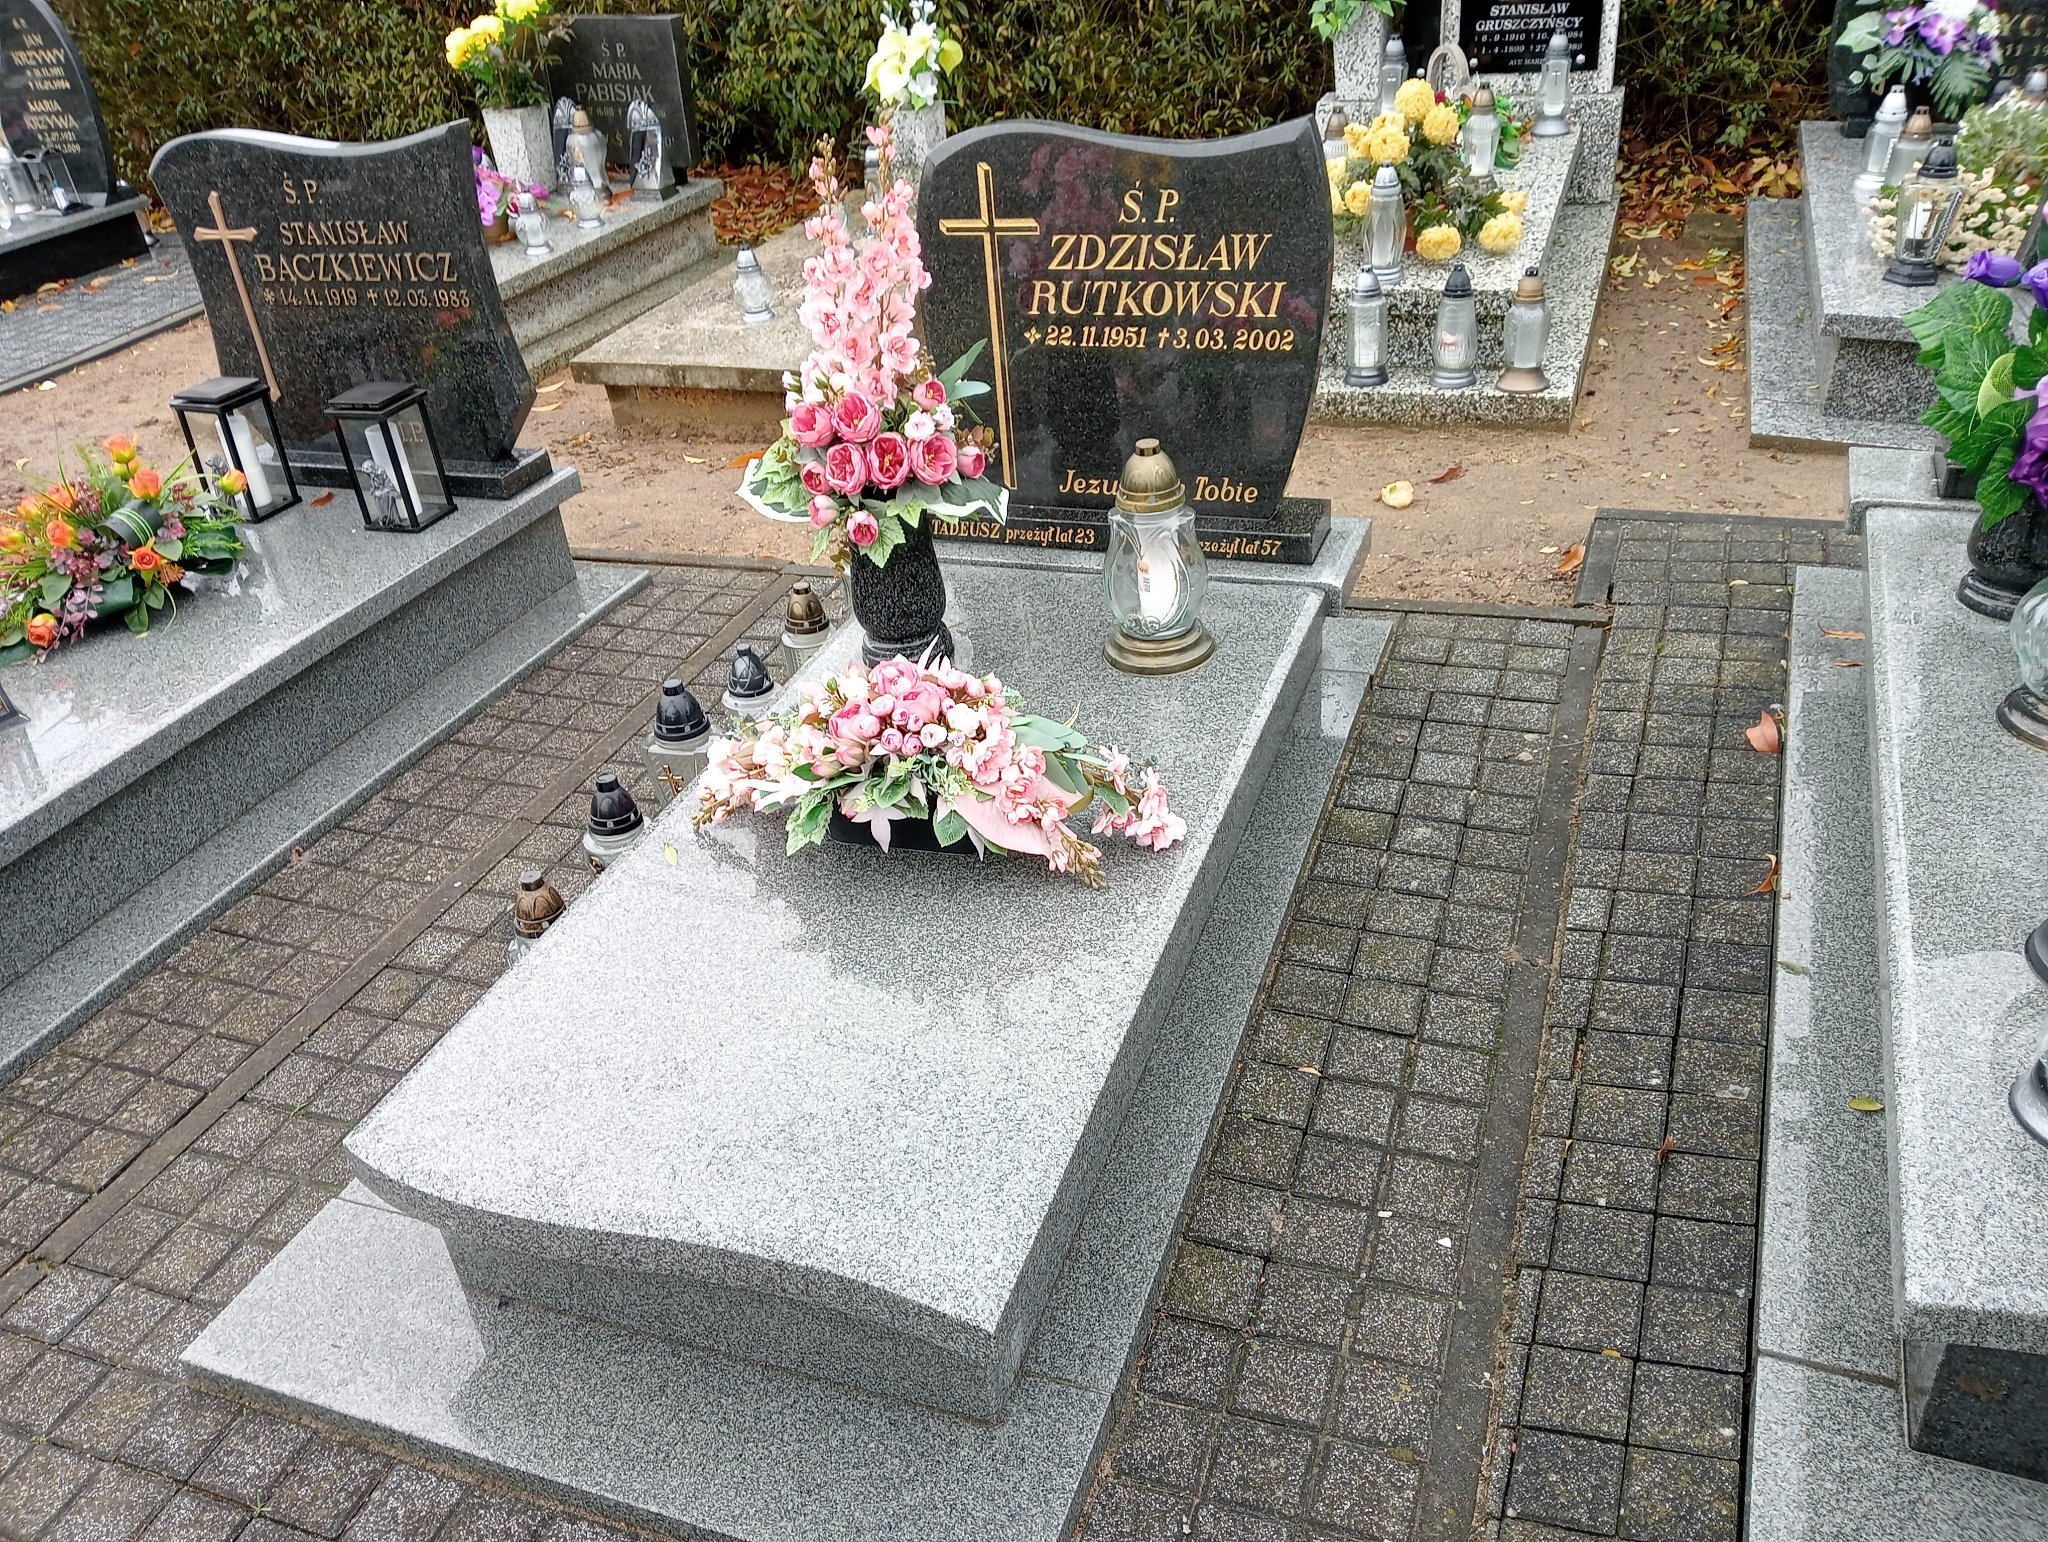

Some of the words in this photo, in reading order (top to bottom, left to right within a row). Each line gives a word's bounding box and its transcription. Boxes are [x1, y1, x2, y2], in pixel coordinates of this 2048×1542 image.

[592, 62, 642, 80] MARIA
[575, 83, 655, 102] PABISIAK
[27, 99, 62, 113] MARIA
[23, 114, 78, 130] KRZYWA
[279, 220, 409, 246] STANISŁAW
[1048, 233, 1272, 271] ZDZISŁAW
[255, 252, 458, 285] BĄCZKIEWICZ
[1028, 280, 1287, 318] RUTKOWSKI
[1193, 476, 1258, 503] Tobie
[932, 519, 1000, 539] TADEUSZ
[1005, 526, 1054, 546] przeżył
[1056, 527, 1073, 543] lat
[1075, 528, 1095, 545] 23
[1199, 537, 1240, 559] zeżył
[1241, 538, 1258, 555] lat
[1260, 540, 1283, 556] 57
